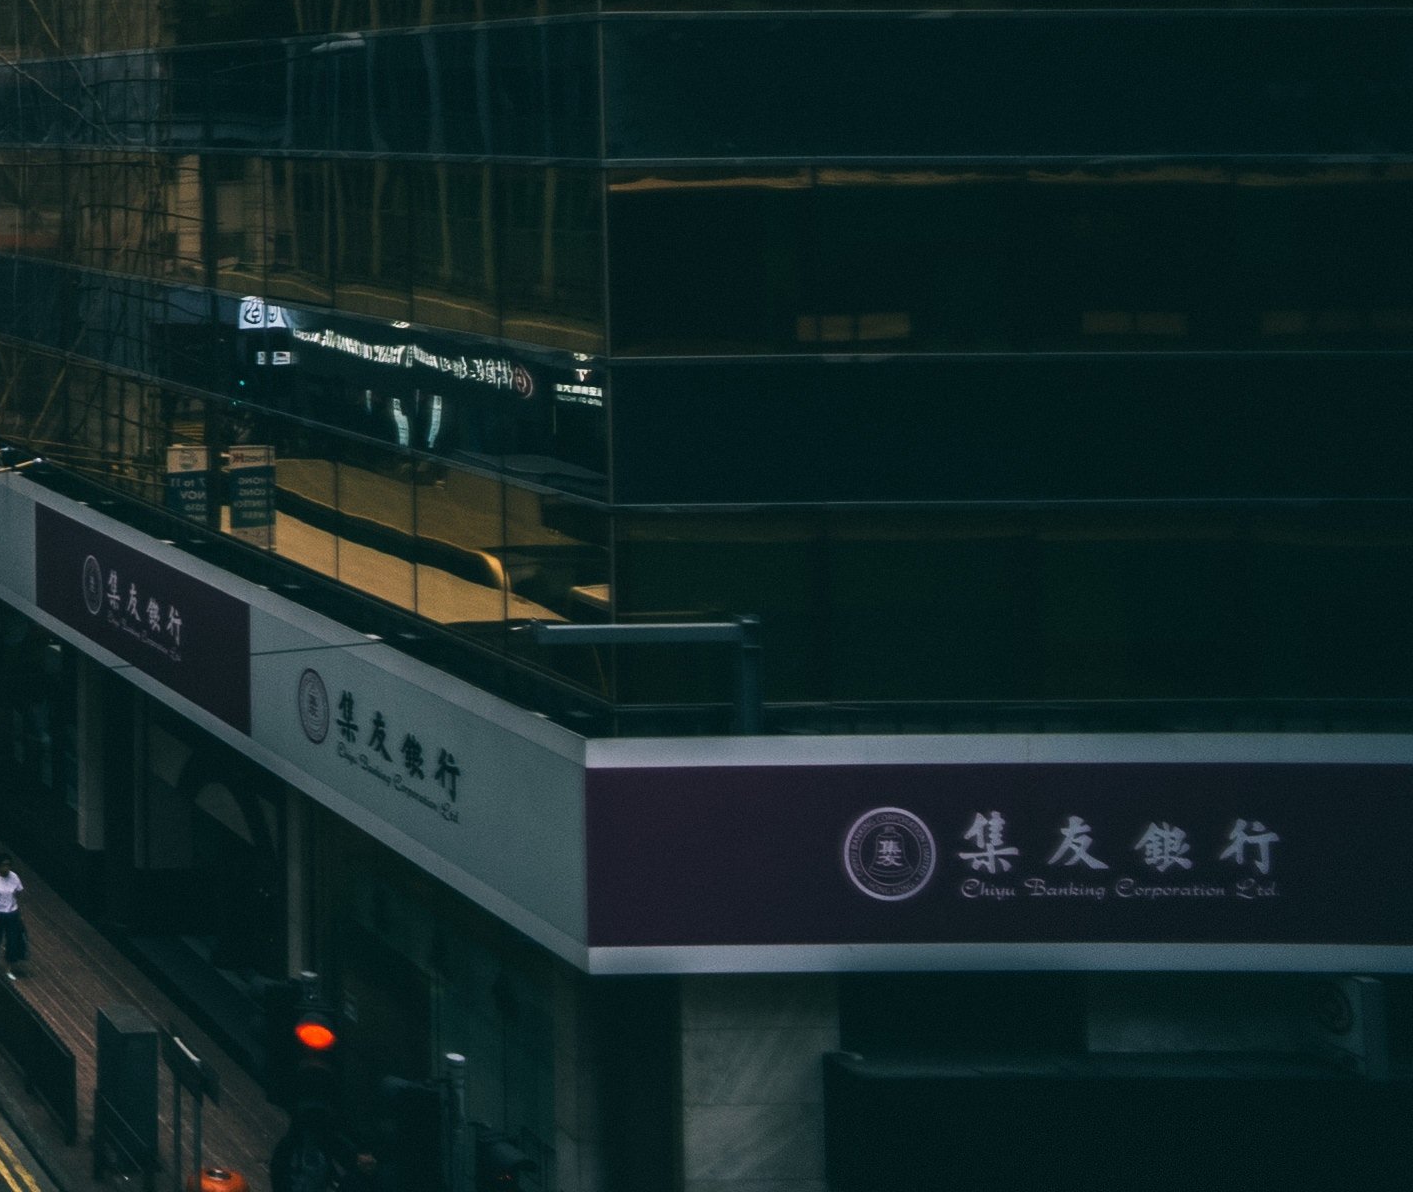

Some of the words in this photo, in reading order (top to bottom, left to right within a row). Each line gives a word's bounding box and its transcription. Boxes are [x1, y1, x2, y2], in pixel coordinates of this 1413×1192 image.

[107, 570, 182, 646] 集友銀行
[336, 690, 461, 803] 集友銀行
[958, 810, 1280, 874] 集友銀行
[960, 878, 1016, 899] Chiyu
[1023, 878, 1106, 900] Banking
[1114, 878, 1226, 899] Corporation
